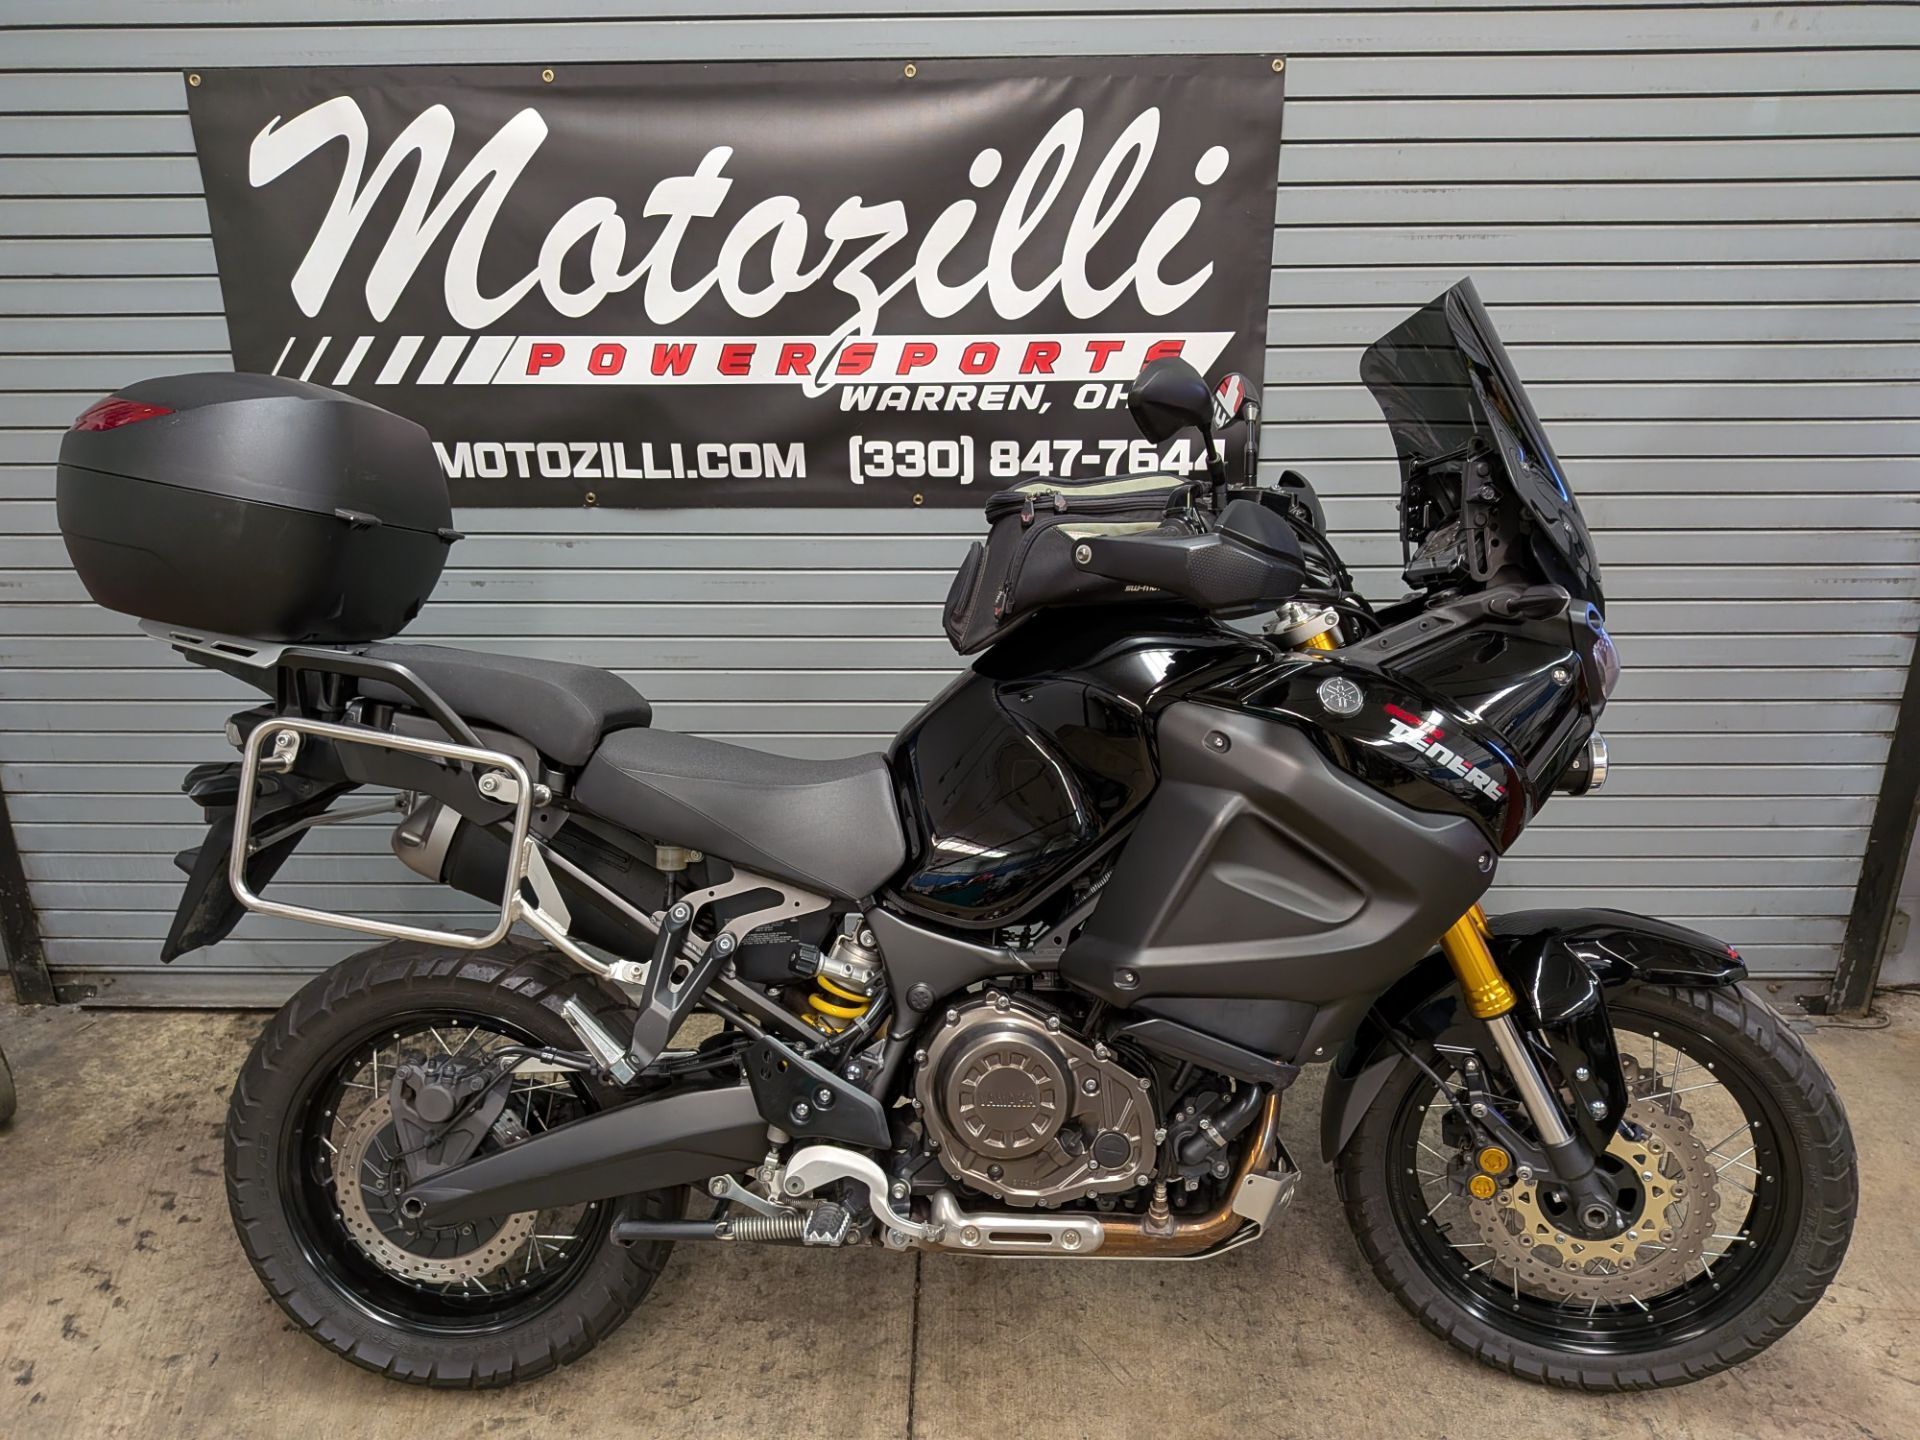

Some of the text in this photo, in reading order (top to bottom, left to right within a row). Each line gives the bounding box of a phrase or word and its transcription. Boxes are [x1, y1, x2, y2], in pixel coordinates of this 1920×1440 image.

[249, 96, 1229, 399] Motozilli
[527, 339, 1187, 376] POWERSPORTS
[840, 384, 1050, 413] WARREN,
[432, 441, 806, 479] MOTOZILLI.COM
[849, 436, 974, 485] (330)
